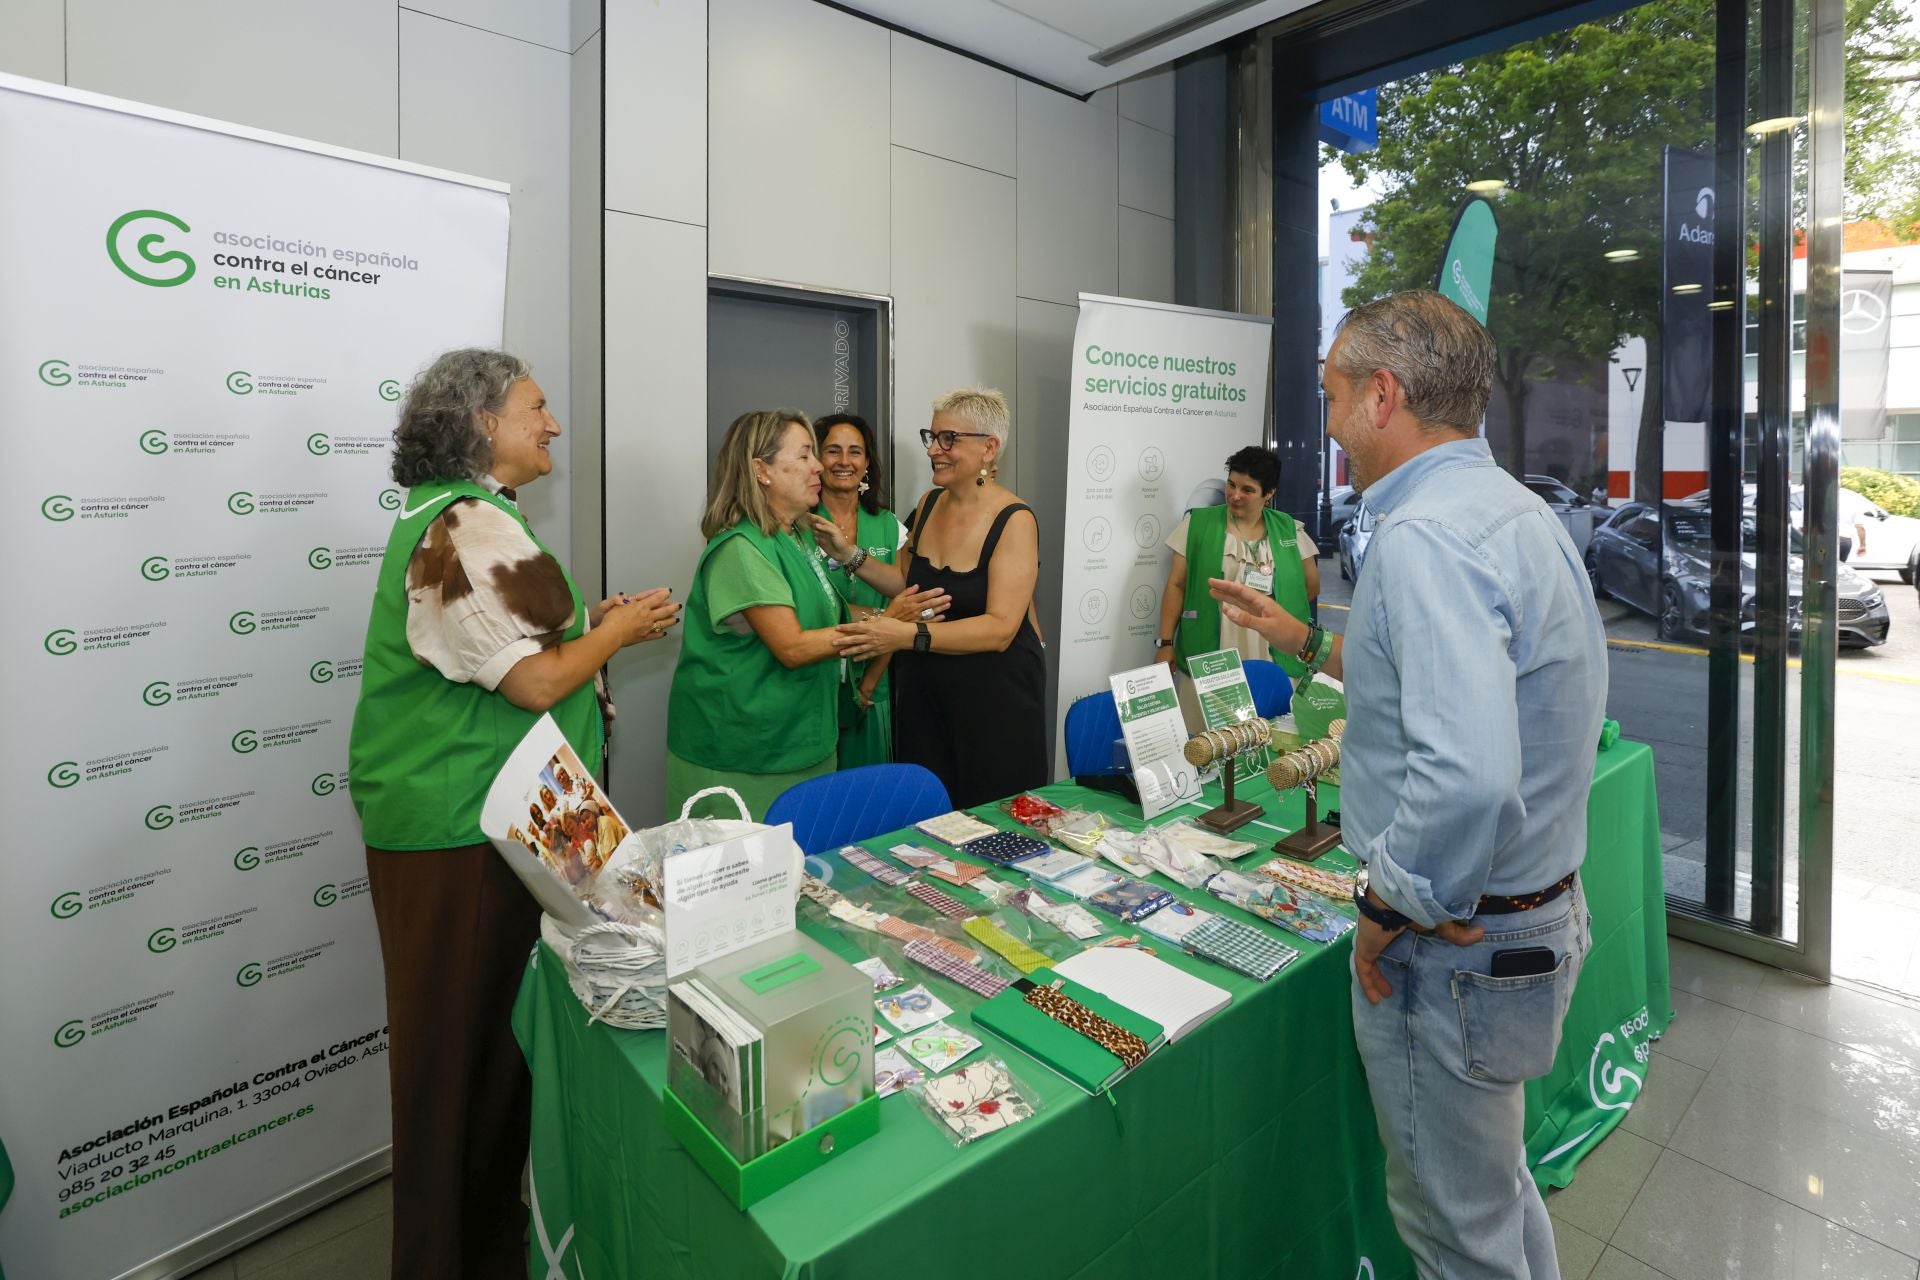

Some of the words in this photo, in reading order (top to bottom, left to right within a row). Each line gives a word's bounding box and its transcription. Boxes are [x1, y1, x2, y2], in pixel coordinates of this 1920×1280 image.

[1331, 96, 1368, 132] ATM
[214, 232, 326, 258] asociación
[333, 250, 417, 270] española
[213, 253, 285, 273] contra
[290, 261, 308, 277] el
[313, 264, 381, 285] cáncer
[213, 276, 241, 290] en
[246, 276, 331, 300] Asturias
[1085, 344, 1159, 369] Conoce
[1163, 356, 1237, 376] nuestros
[91, 380, 126, 388] Asturias
[1084, 375, 1167, 397] servicios
[1171, 381, 1246, 403] gratuitos
[1153, 406, 1175, 415] Contra
[1175, 407, 1182, 415] el
[83, 635, 112, 643] contra
[122, 631, 151, 639] cáncer
[96, 641, 130, 650] Asturias
[177, 686, 202, 694] contra
[188, 691, 219, 700] Asturias
[86, 763, 114, 773] contra
[124, 755, 153, 766] cáncer
[98, 767, 132, 779] Asturias
[179, 807, 205, 816] contra
[214, 800, 240, 809] cáncer
[190, 811, 221, 822] Asturias
[88, 890, 116, 901] contra
[127, 879, 155, 891] cáncer
[101, 893, 134, 906] Asturias
[182, 927, 207, 938] contra
[217, 918, 243, 928] cáncer
[193, 930, 224, 942] Asturias
[91, 1015, 119, 1028] contra
[129, 1002, 158, 1015] cáncer
[103, 1017, 137, 1032] Asturias
[57, 1113, 164, 1164] Asociación
[168, 1081, 249, 1121] Española
[252, 1060, 308, 1085] Contra
[311, 1049, 326, 1064] el
[328, 1028, 381, 1056] Cáncer
[57, 1140, 143, 1181] Viaducto
[149, 1105, 232, 1145] Marquina,
[252, 1077, 300, 1105] 33004
[361, 1041, 390, 1060] Astu
[58, 1104, 315, 1219] asociacioncontraelcancer.es
[58, 1177, 95, 1202] 985
[100, 1165, 124, 1183] 20
[128, 1155, 150, 1174] 32
[154, 1145, 176, 1161] 45
